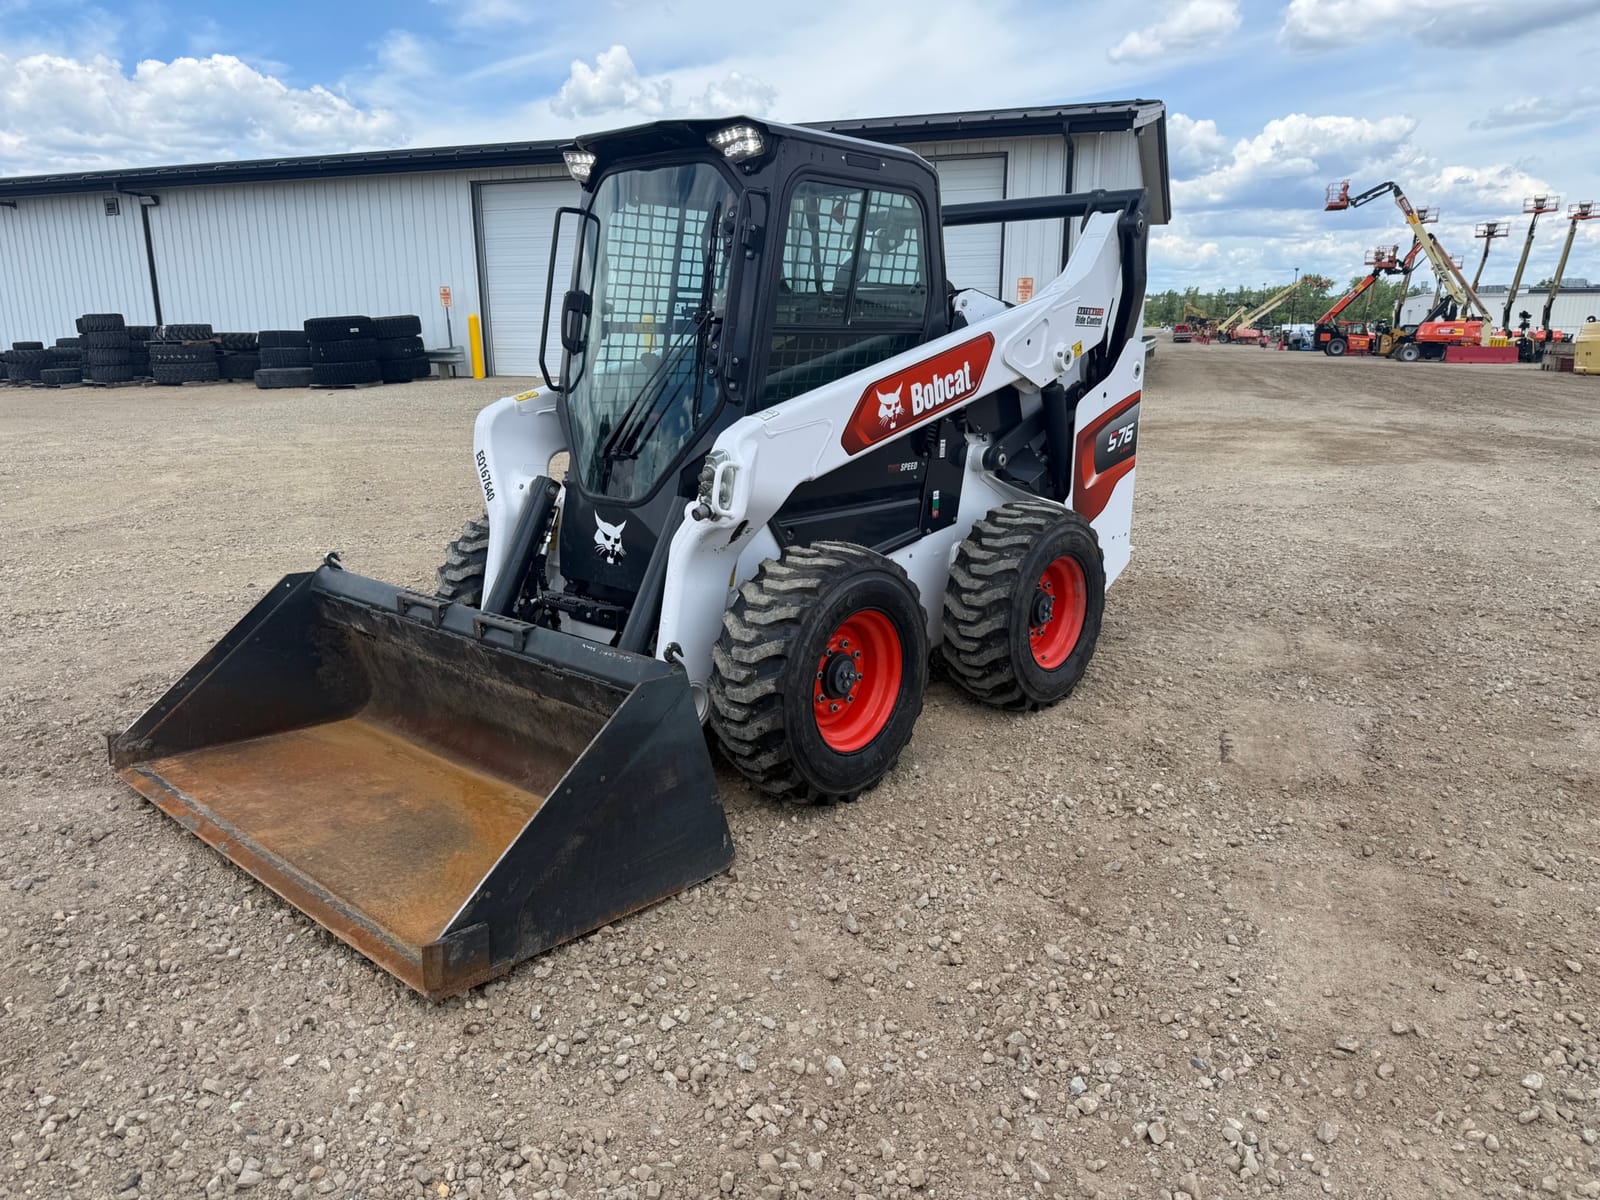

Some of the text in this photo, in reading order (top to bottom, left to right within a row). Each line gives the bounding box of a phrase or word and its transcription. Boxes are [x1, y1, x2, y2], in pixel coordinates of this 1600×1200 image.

[910, 361, 972, 417] Bobcat
[1107, 422, 1135, 453] S76
[900, 461, 918, 472] SPEED
